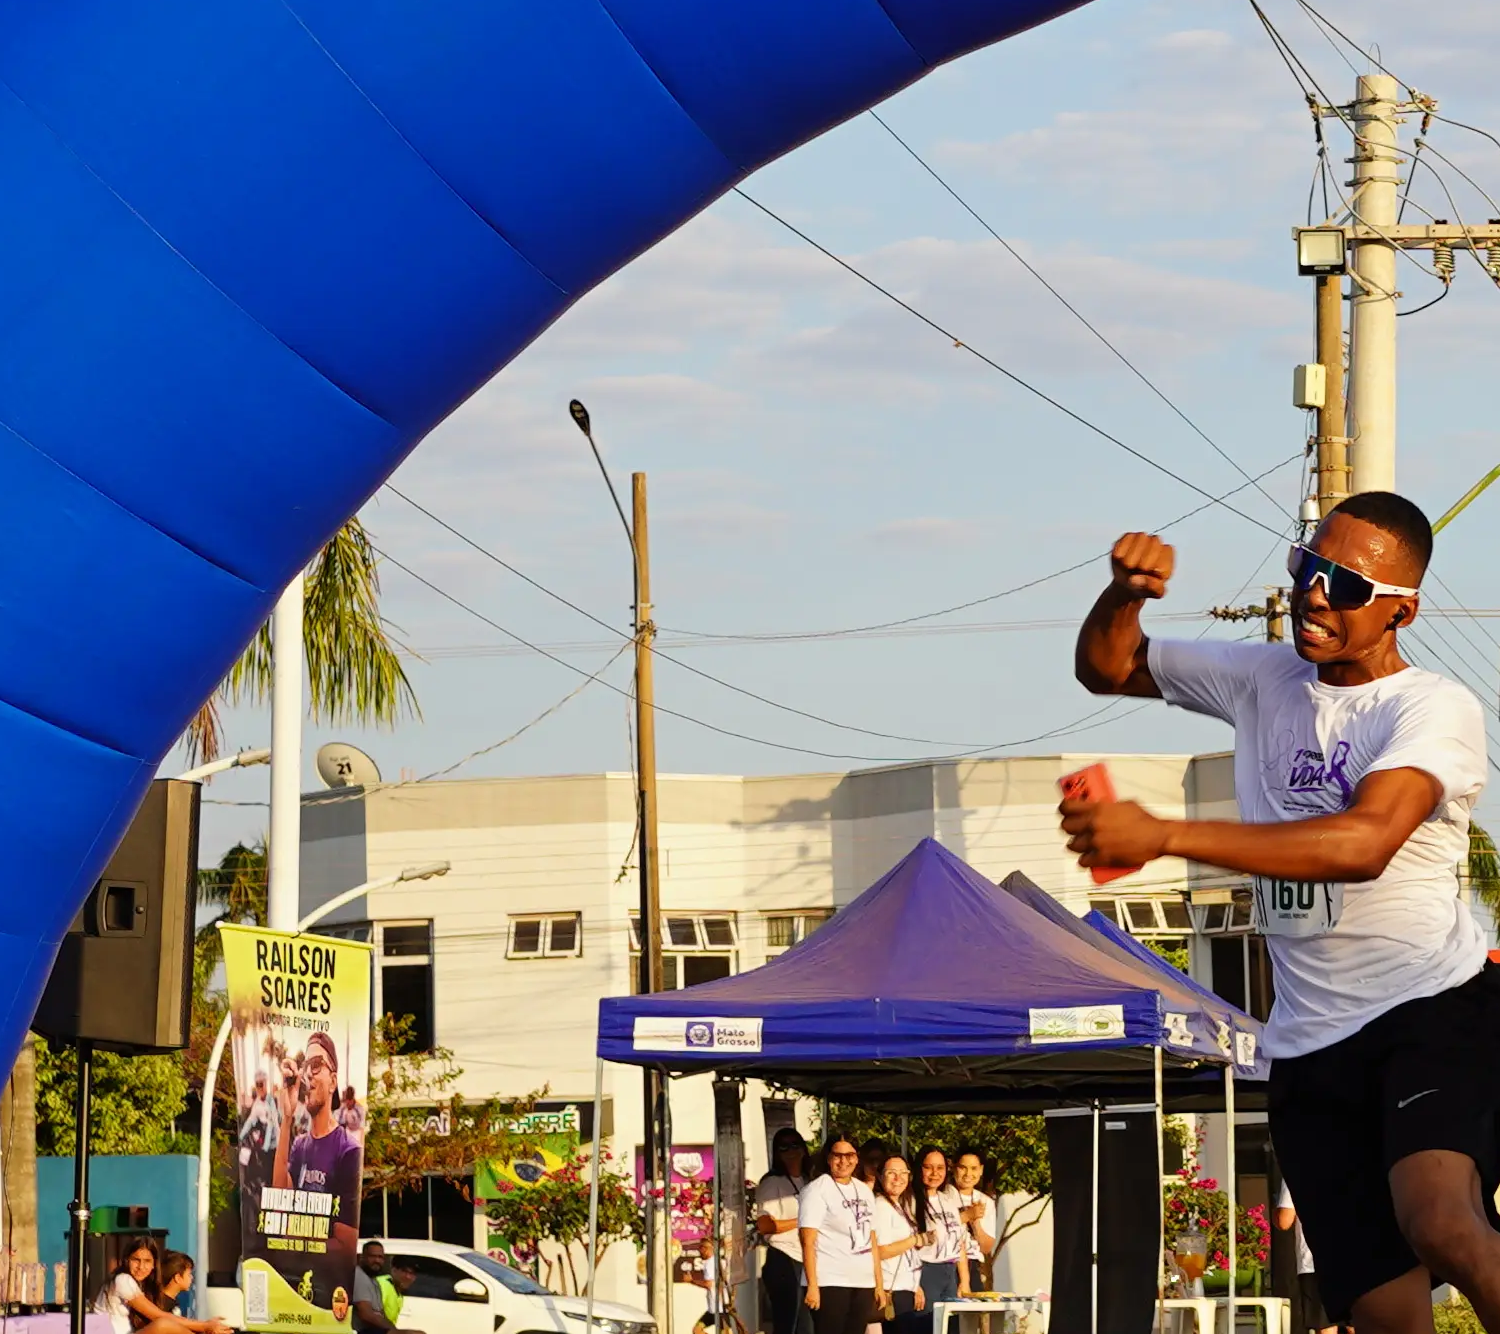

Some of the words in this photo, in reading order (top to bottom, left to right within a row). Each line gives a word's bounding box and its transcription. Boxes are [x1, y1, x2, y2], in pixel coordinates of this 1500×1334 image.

[256, 939, 336, 980] RAILSON
[261, 974, 332, 1014] SOARES
[293, 1016, 330, 1032] ESPORTIVO
[716, 1037, 756, 1046] Grosso
